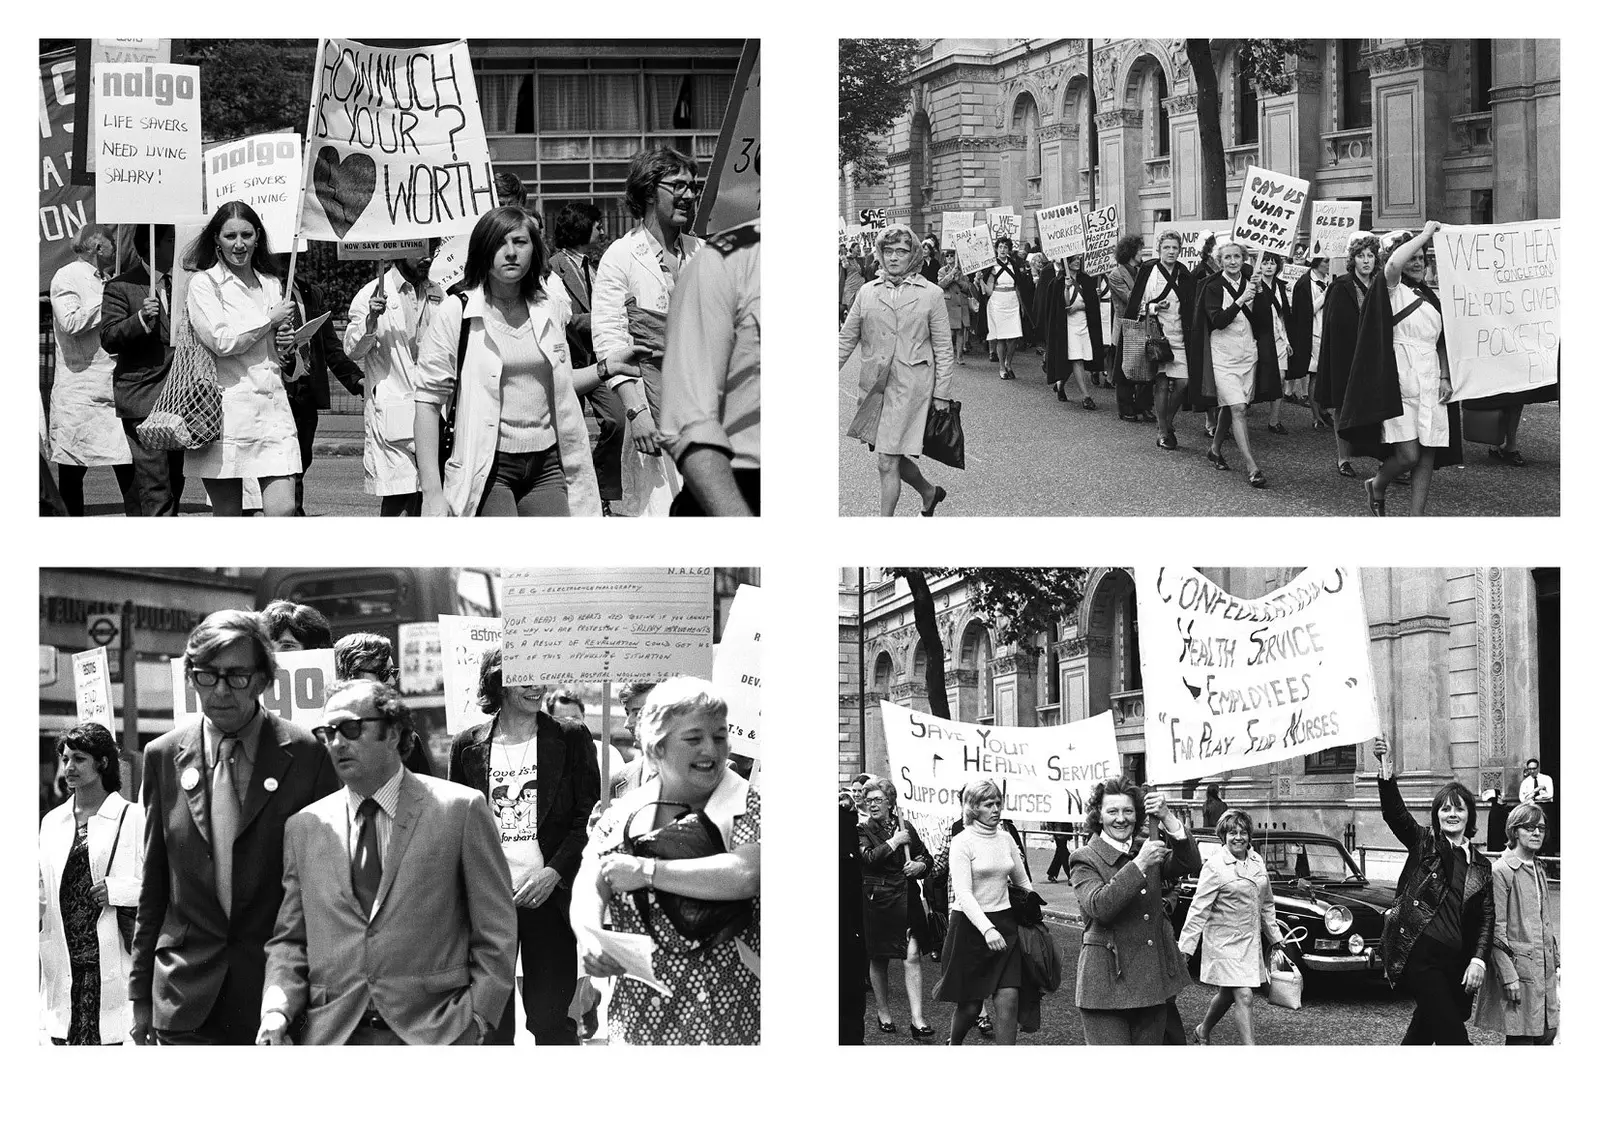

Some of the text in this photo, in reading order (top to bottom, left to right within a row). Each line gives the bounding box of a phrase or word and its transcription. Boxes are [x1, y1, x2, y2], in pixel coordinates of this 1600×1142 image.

[103, 66, 193, 106] nalgo
[376, 52, 462, 111] MUCH
[103, 113, 188, 132] LIFE SAVERS
[344, 102, 421, 155] YOUR
[434, 104, 466, 161] ?
[102, 141, 187, 160] NEED LIVING
[212, 139, 295, 175] nalgo
[216, 175, 287, 198] LIFE SAVERS
[384, 161, 496, 226] WORTH
[1251, 176, 1305, 204] PAY US
[250, 192, 288, 206] LIVING
[1252, 195, 1295, 220] WHAT
[39, 200, 88, 241] ON
[860, 208, 885, 226] SAVE
[999, 215, 1014, 225] WE
[1041, 204, 1079, 220] UNIONS
[1087, 206, 1116, 230] £30
[1316, 215, 1355, 228] BLEED
[870, 219, 886, 229] THE
[1047, 224, 1082, 240] WORKERS
[1247, 214, 1288, 237] WE'RE
[344, 242, 360, 250] NOW
[1087, 239, 1110, 251] NEED
[1181, 232, 1200, 244] NUR
[1236, 226, 1292, 250] WORTH!
[446, 253, 455, 262] OF
[1086, 256, 1110, 269] NEED
[1446, 231, 1519, 271] WEST
[1452, 285, 1515, 318] HEARTS
[1477, 320, 1557, 358] POCKETS
[504, 616, 526, 629] YOUR
[631, 623, 662, 634] SALARY
[1177, 617, 1325, 669] HEALTH SERVICE
[506, 673, 534, 684] BROOK
[540, 672, 573, 680] GENERAL
[1206, 673, 1312, 716] EMPLOYEES
[747, 730, 756, 740] &
[1199, 721, 1235, 761] PLAY
[1283, 708, 1340, 749] NURSES
[964, 744, 1111, 782] HEALTH SERVICE
[901, 766, 964, 804] SUPPOR
[1065, 788, 1083, 815] N
